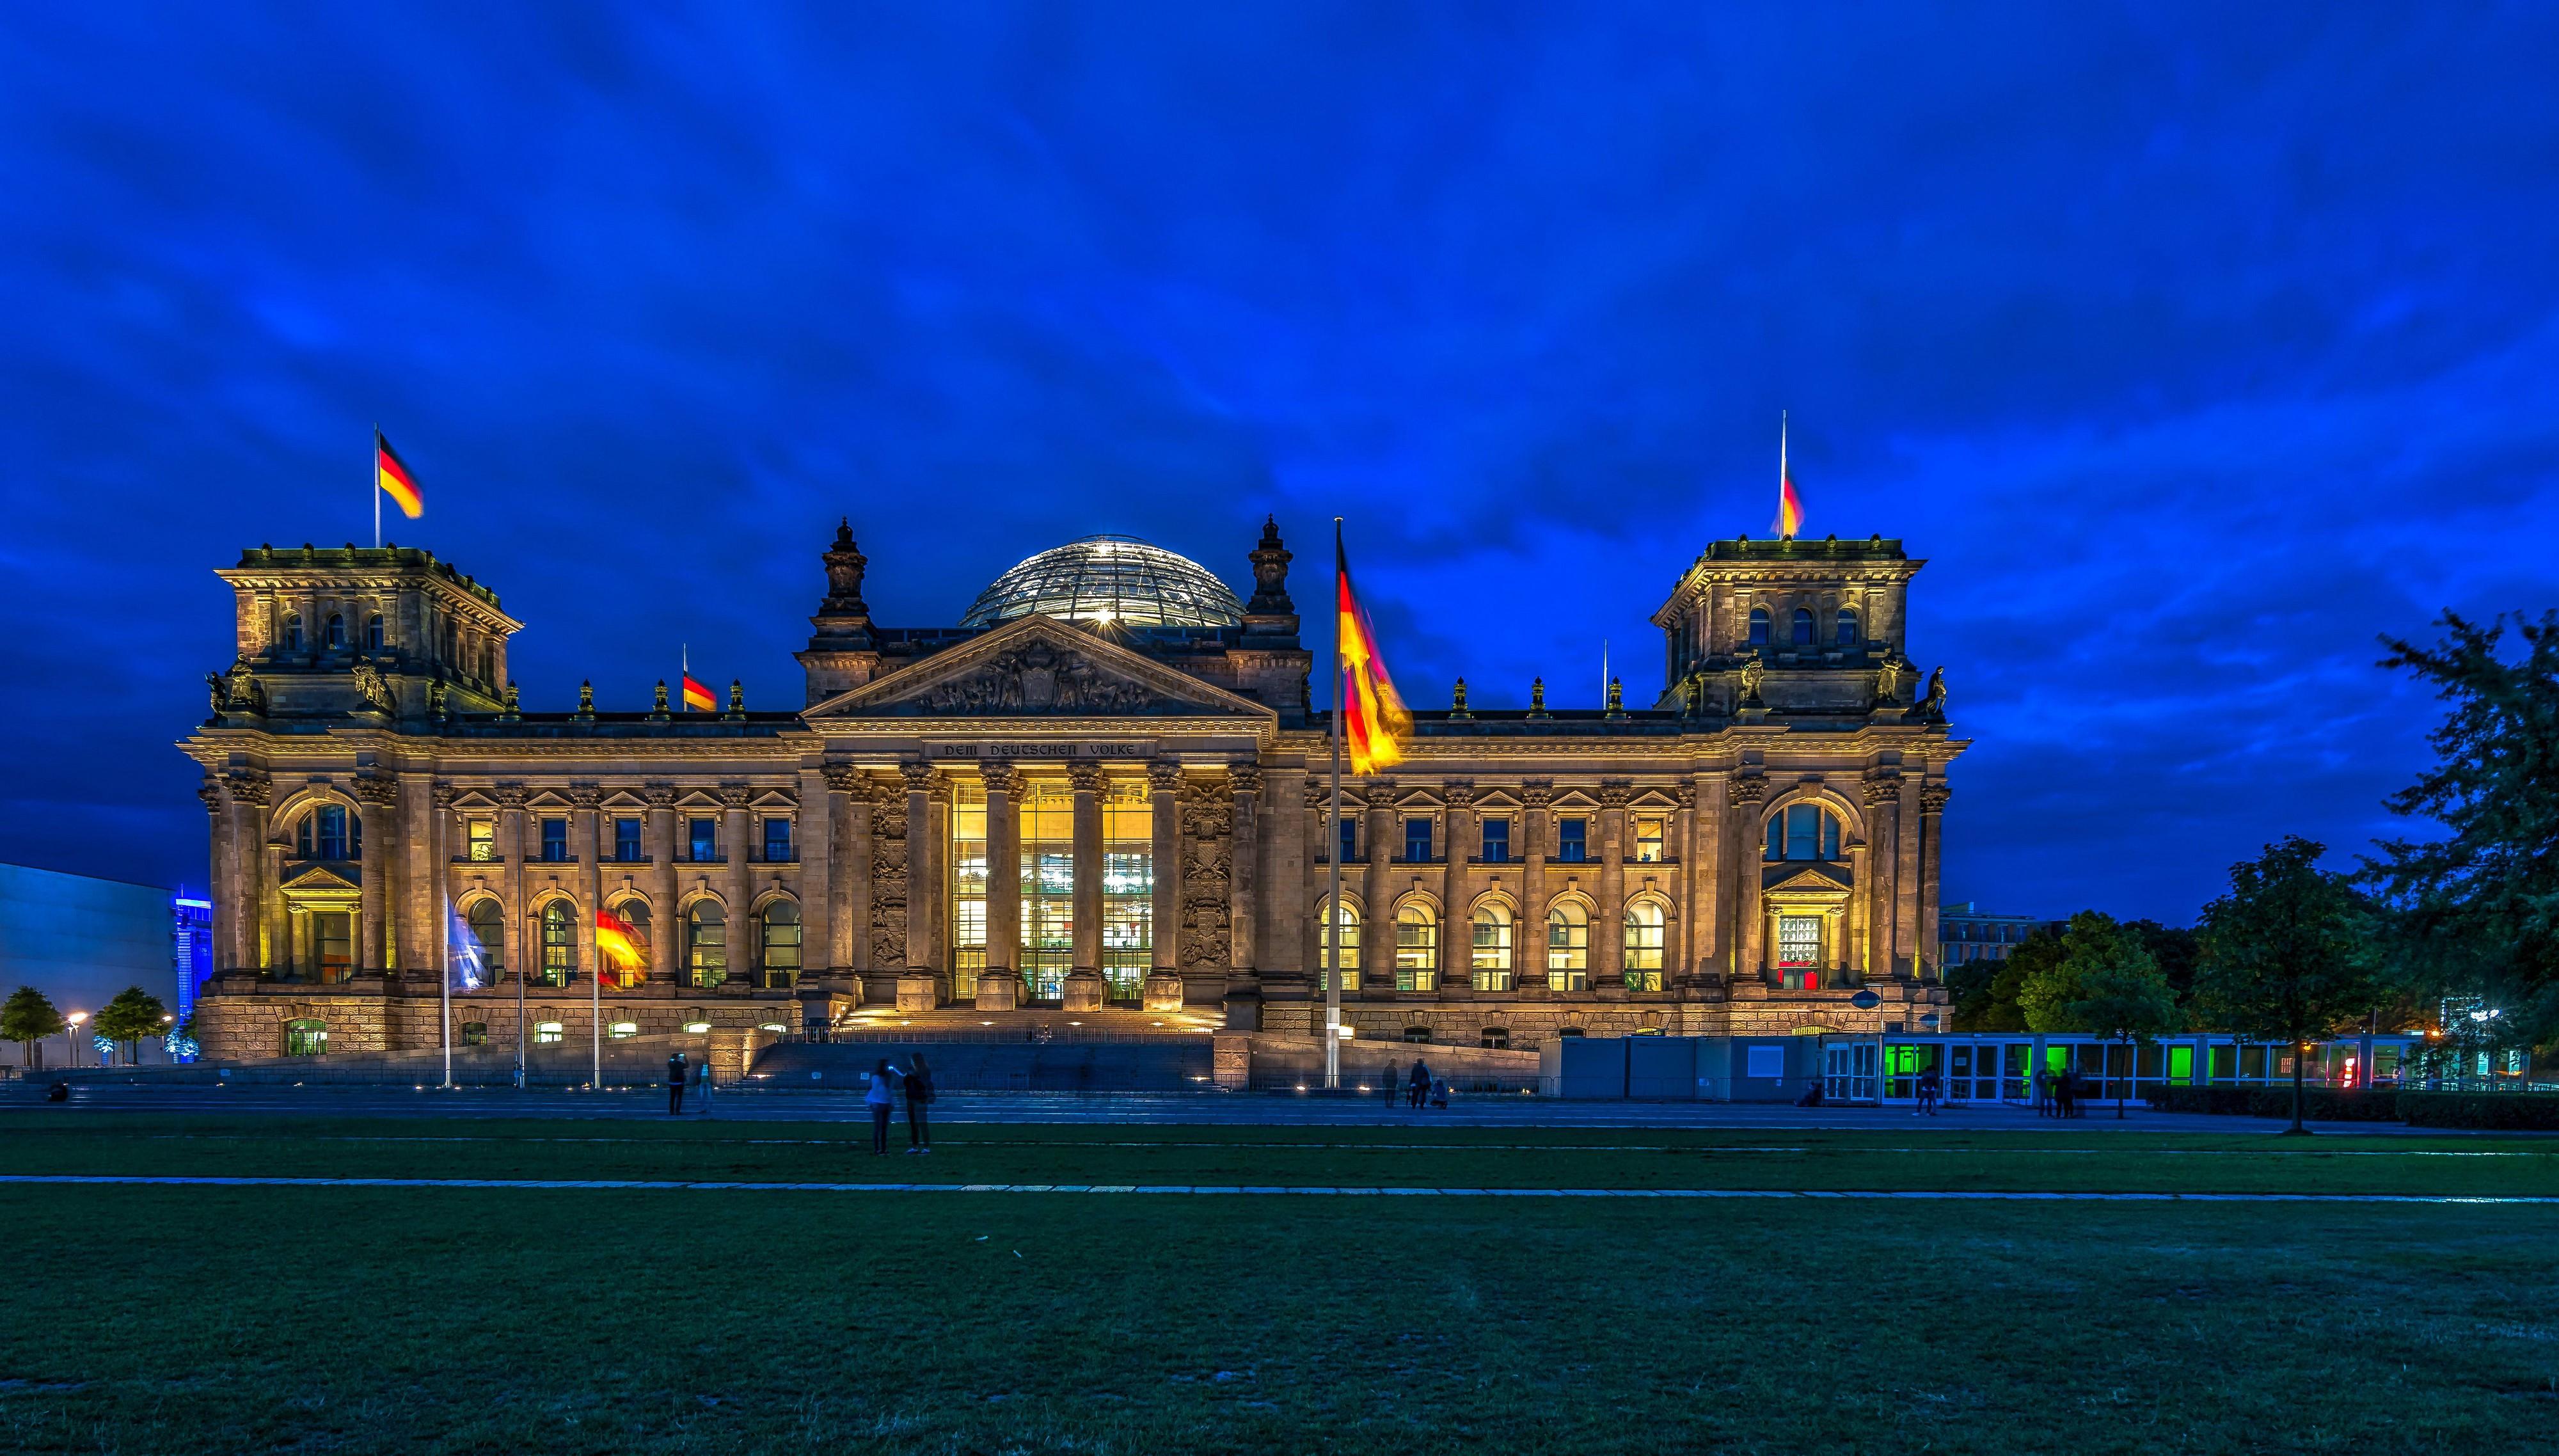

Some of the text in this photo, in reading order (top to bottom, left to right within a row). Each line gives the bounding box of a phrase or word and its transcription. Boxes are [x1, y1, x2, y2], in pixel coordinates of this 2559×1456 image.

[945, 745, 1135, 756] DEM DEUTSCHEN VOLKE
